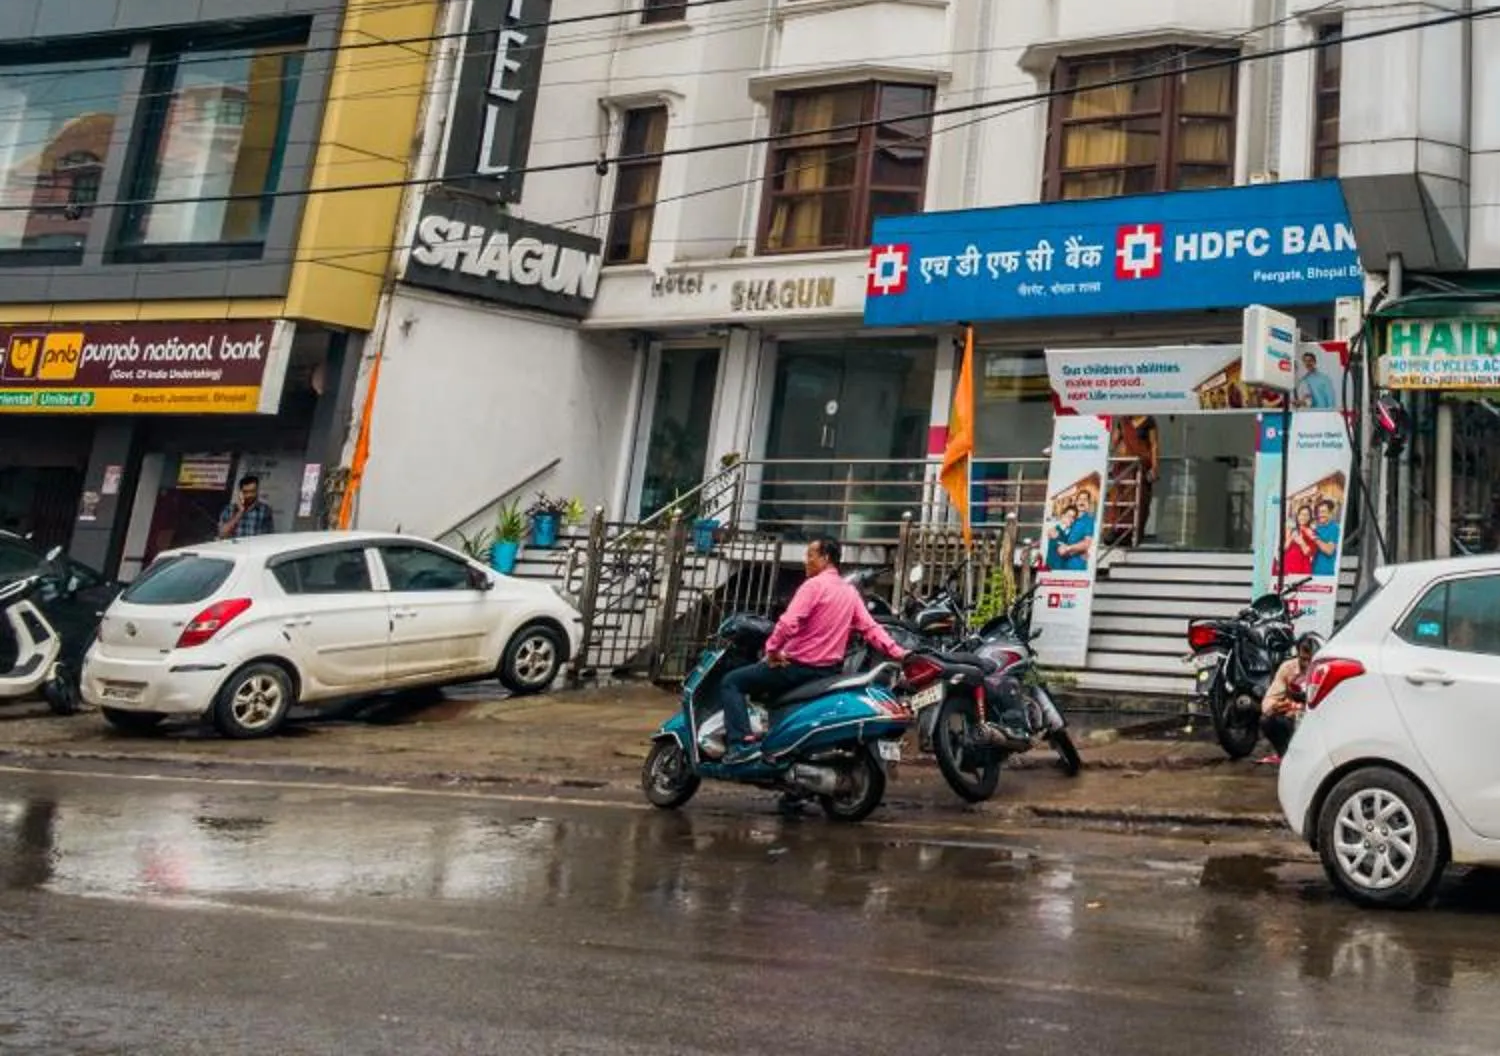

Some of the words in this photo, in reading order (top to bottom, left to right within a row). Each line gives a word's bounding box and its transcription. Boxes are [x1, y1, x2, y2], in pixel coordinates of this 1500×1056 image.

[411, 213, 600, 300] SHAGUN
[919, 255, 950, 284] एच
[956, 244, 982, 276] डी
[987, 249, 1020, 279] एफ
[1026, 240, 1054, 272] सी
[1064, 235, 1104, 269] बैंक
[1175, 227, 1270, 262] HDFC
[1282, 223, 1357, 255] BAN
[1253, 269, 1304, 283] Peergate,
[1307, 265, 1346, 280] Bhopal
[652, 272, 704, 297] Hotel
[730, 277, 836, 312] SHAGUN
[43, 343, 78, 368] pnb
[80, 336, 140, 368] punjab
[143, 335, 215, 361] national
[220, 333, 264, 360] bank
[1083, 362, 1134, 375] children's
[1136, 361, 1180, 374] abilities
[40, 393, 74, 405] United
